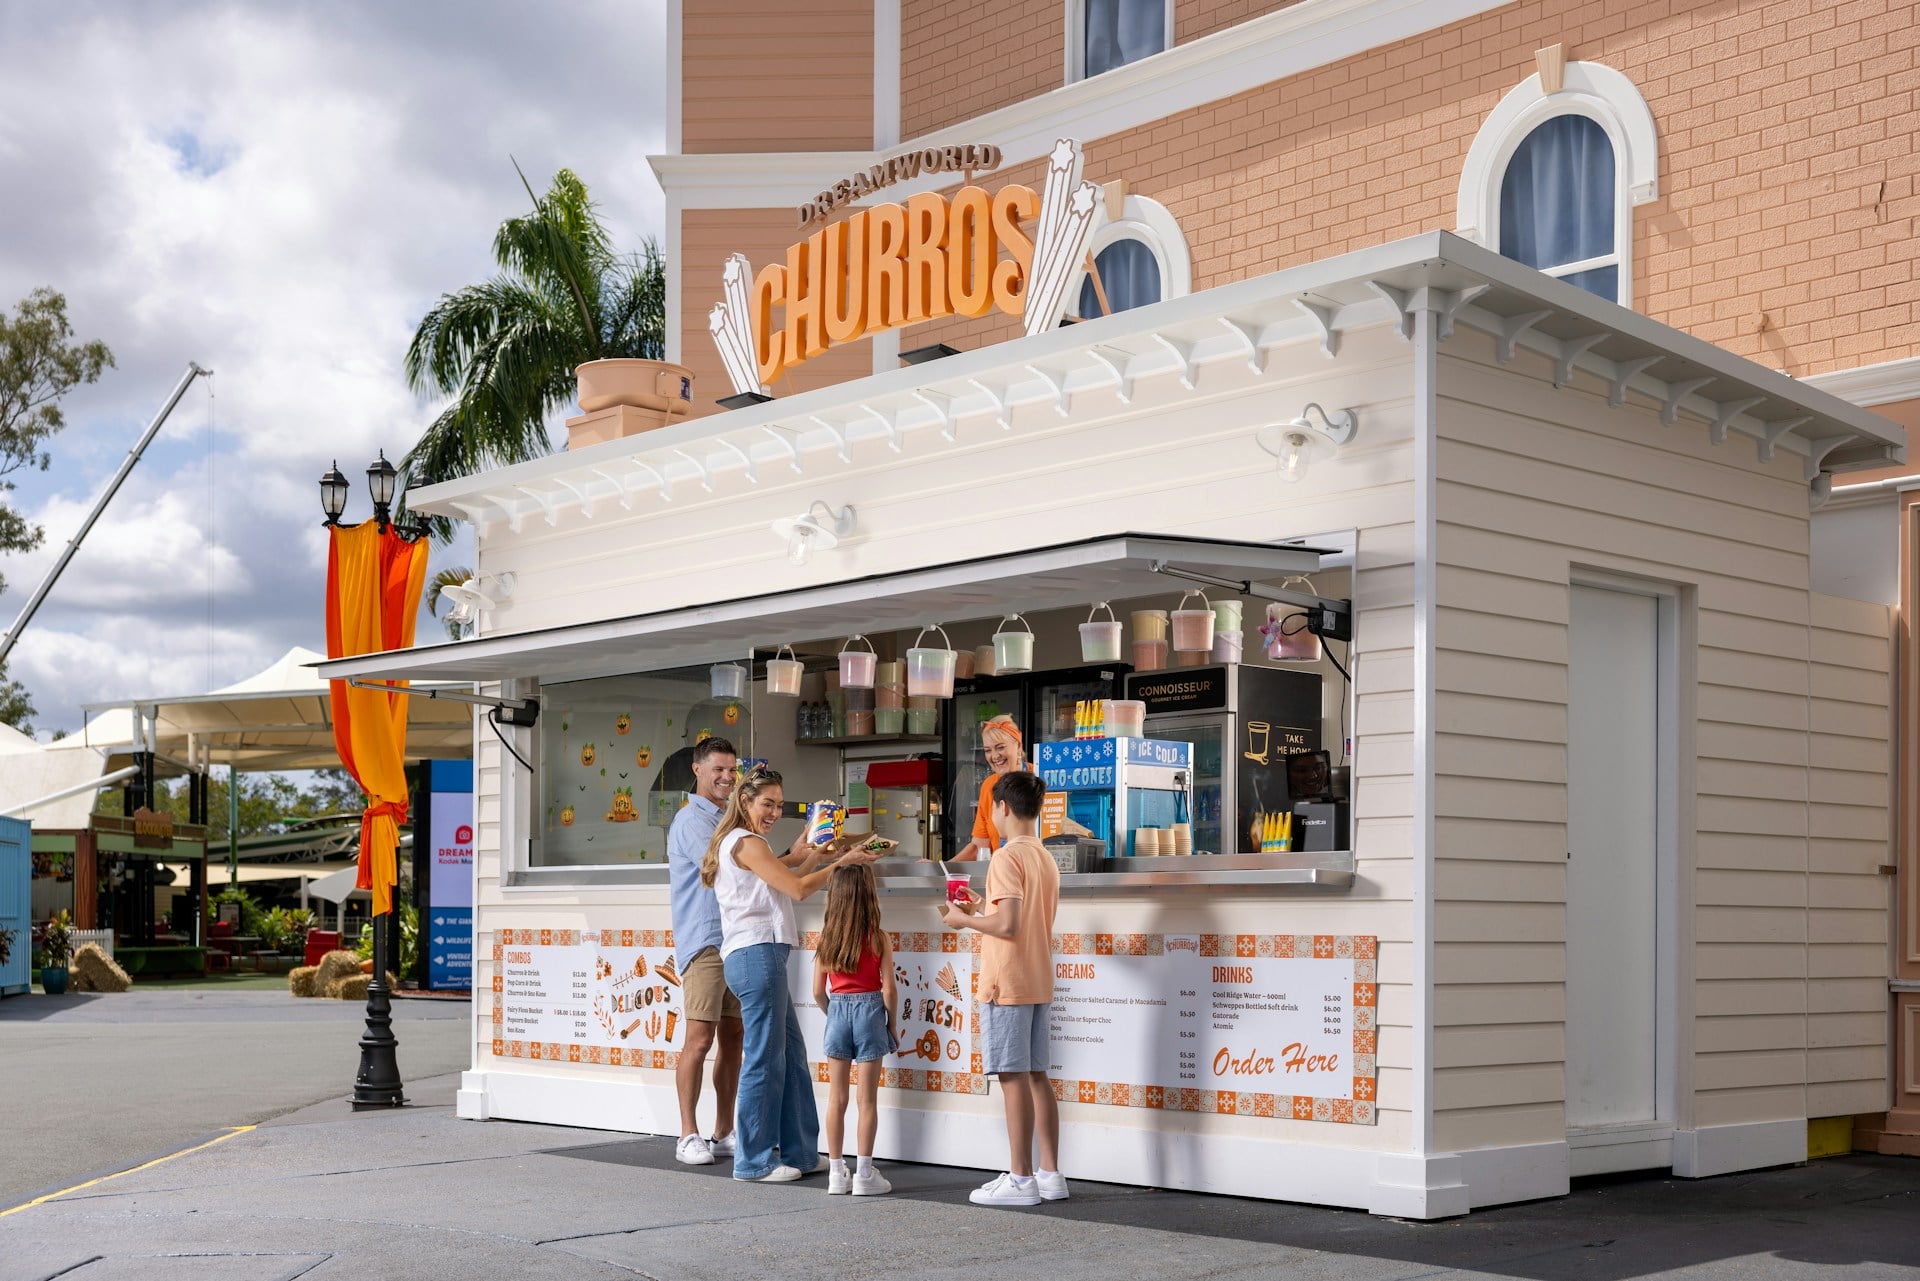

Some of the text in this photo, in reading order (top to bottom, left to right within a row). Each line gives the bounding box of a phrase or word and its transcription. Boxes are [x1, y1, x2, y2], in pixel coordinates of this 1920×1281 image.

[797, 142, 1003, 231] DREAMWORLD
[751, 184, 1042, 386] CHURROS
[1138, 681, 1210, 697] CONNOISSEUR
[1285, 734, 1304, 744] TAKE
[1138, 742, 1178, 764] ICE COLD
[1276, 745, 1288, 755] ME
[1044, 766, 1113, 787] SNO-CONES
[507, 951, 532, 964] COMBOS
[1056, 963, 1095, 979] CREAMS
[1212, 966, 1253, 984] DRINKS
[611, 985, 672, 1014] DELICIOUS
[1088, 996, 1105, 1004] Salted
[1105, 997, 1128, 1005] Caramel
[1135, 998, 1167, 1006] Macadamia
[1212, 991, 1226, 999] Cool
[1226, 991, 1243, 1000] Ridge
[1243, 992, 1262, 1000] Water
[1267, 993, 1287, 1001] 600ml
[1212, 1002, 1245, 1011] Schweppes
[1267, 1003, 1281, 1011] Soft
[1323, 1005, 1341, 1013] $6.00
[902, 998, 964, 1034] & FRESH
[1179, 1010, 1196, 1018] $5.50
[1212, 1012, 1240, 1020] Gatorade
[1057, 1015, 1076, 1023] Vanilla
[1082, 1016, 1097, 1025] Super
[1097, 1016, 1112, 1024] Choc
[1323, 1016, 1341, 1024] $6.00
[1212, 1022, 1234, 1030] Atomic
[1323, 1027, 1341, 1035] $6.50
[1086, 1035, 1105, 1044] Cookie
[1179, 1051, 1196, 1059] $5.50
[1212, 1042, 1339, 1077] Order Here
